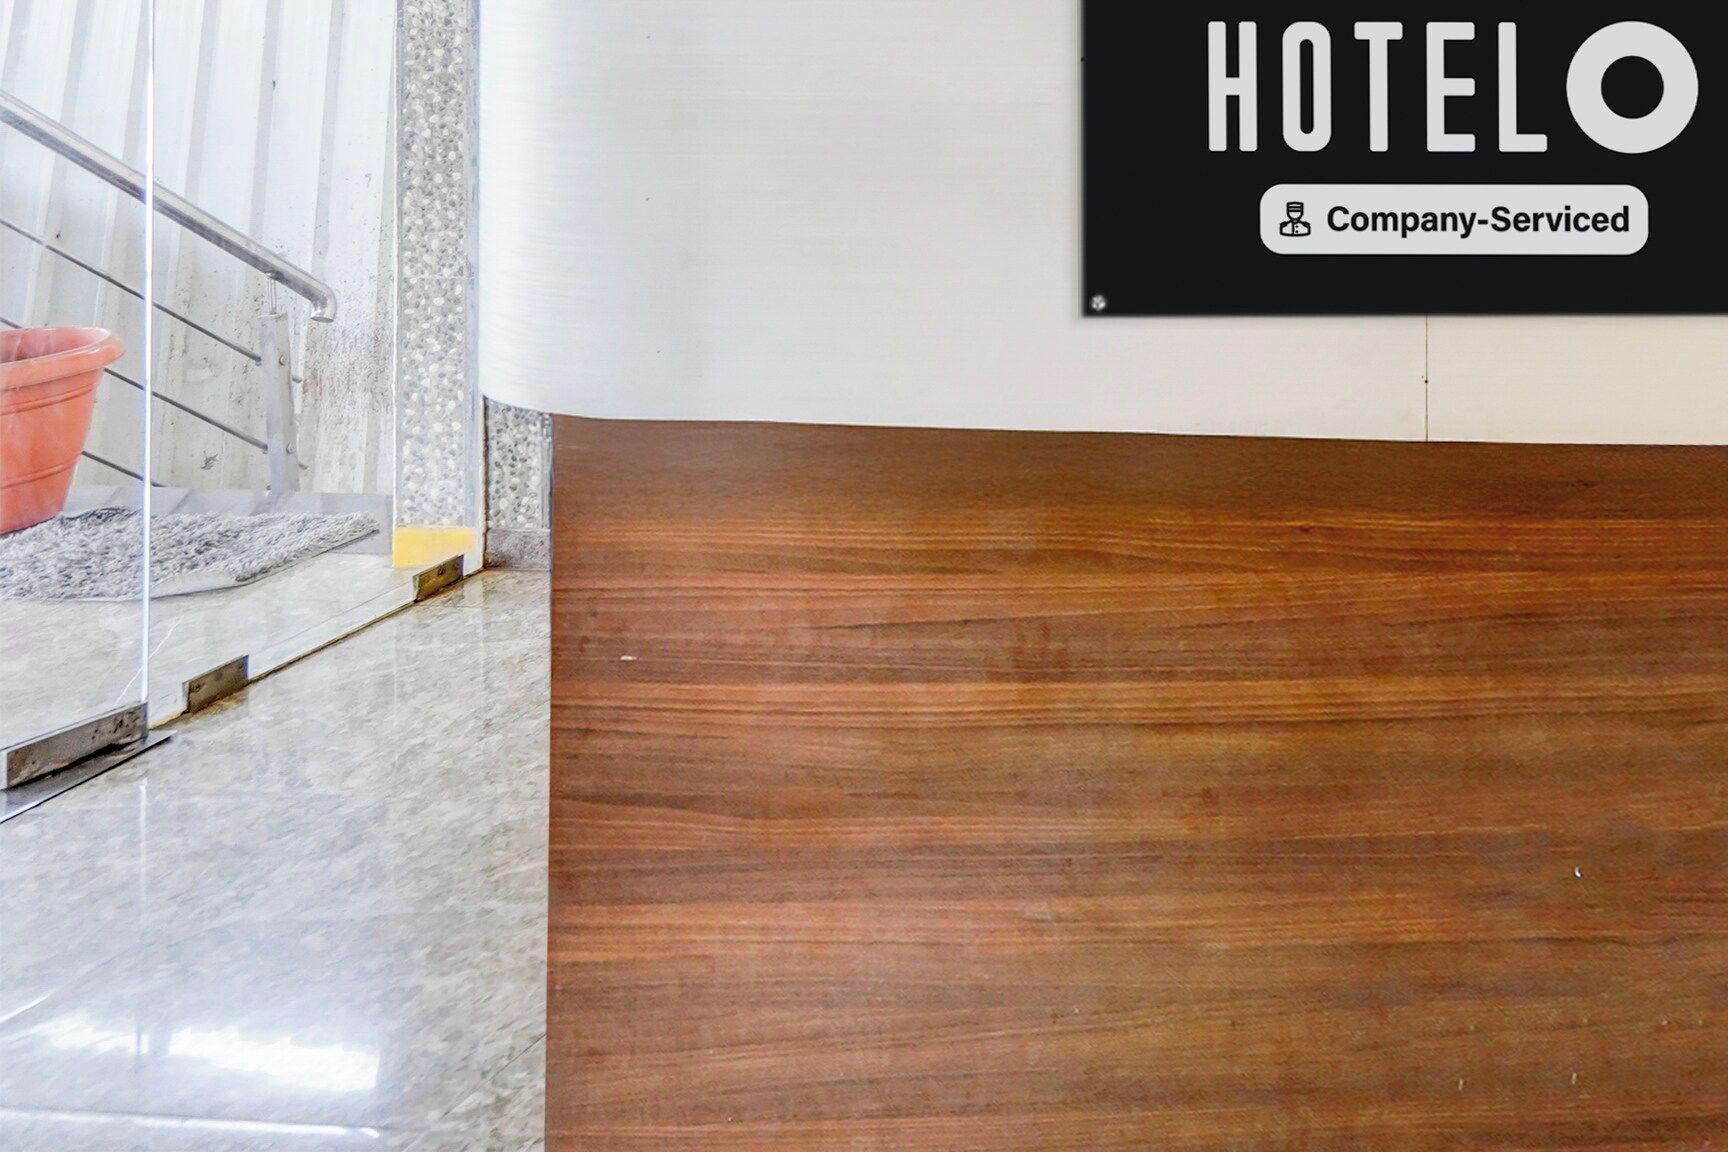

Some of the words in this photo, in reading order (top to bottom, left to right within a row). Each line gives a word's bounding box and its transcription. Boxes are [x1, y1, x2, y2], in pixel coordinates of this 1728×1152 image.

[1208, 21, 1547, 152] HOTEL
[1566, 21, 1698, 153] O
[1328, 206, 1629, 238] Company-Serviced
